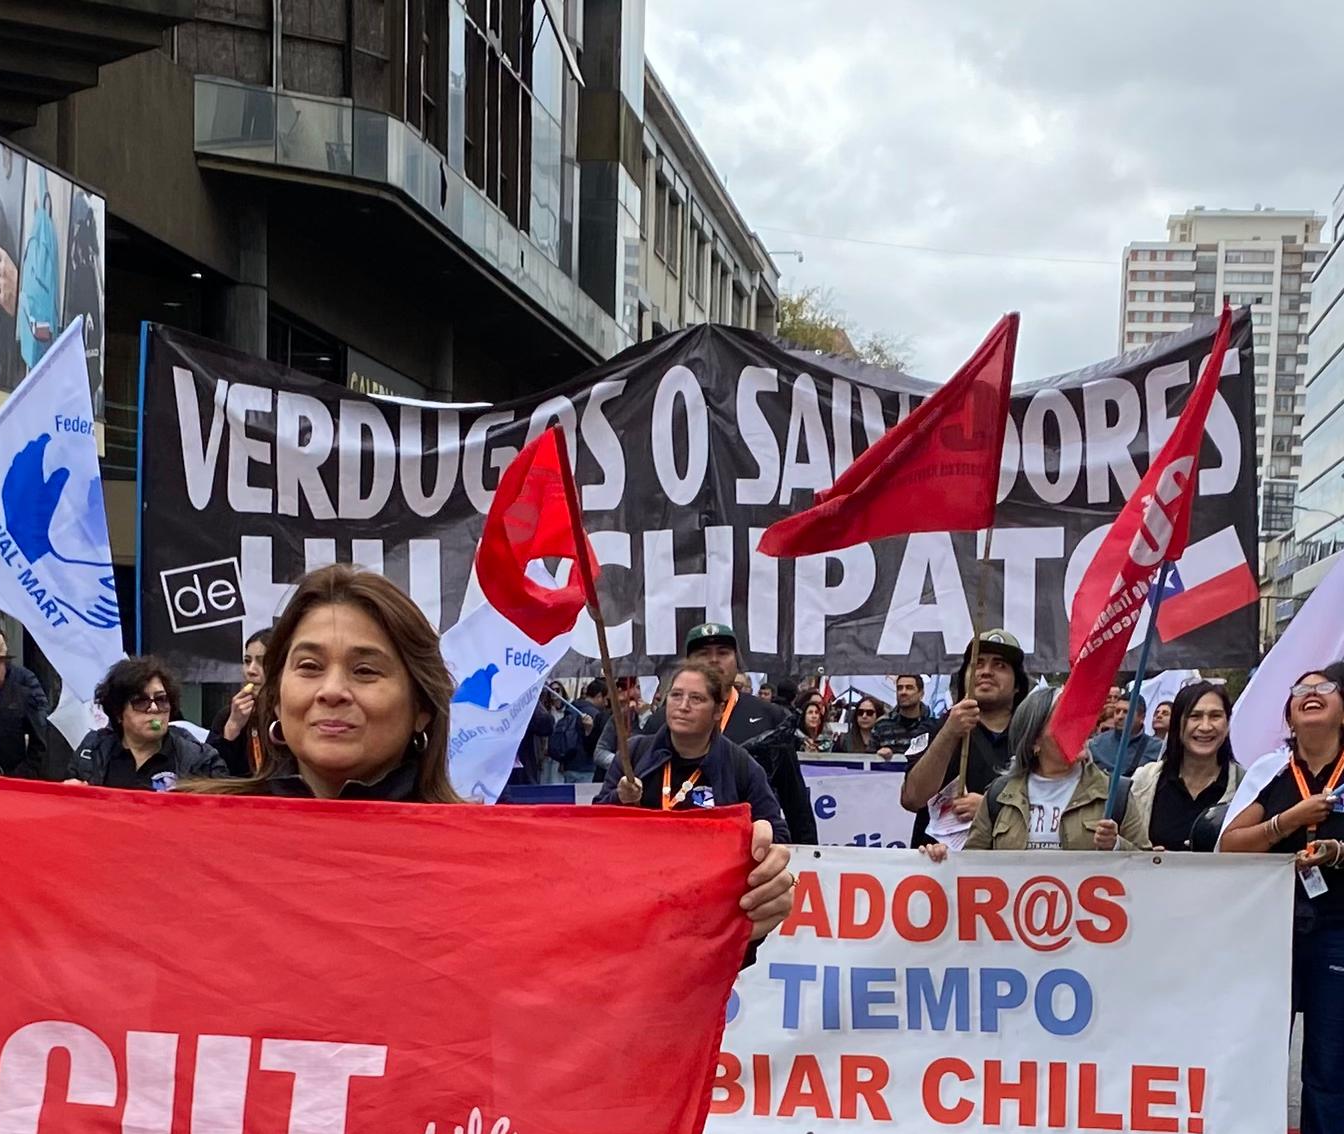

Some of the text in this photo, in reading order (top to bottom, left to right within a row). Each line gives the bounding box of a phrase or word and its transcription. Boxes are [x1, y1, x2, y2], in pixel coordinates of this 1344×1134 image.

[652, 365, 709, 505] O
[735, 348, 1241, 505] SALORES
[173, 574, 238, 618] de
[814, 794, 837, 820] e
[780, 871, 1128, 951] ADOR@S
[768, 962, 1093, 1036] TIEMPO
[710, 1053, 1206, 1134] BIAR CHILE!
